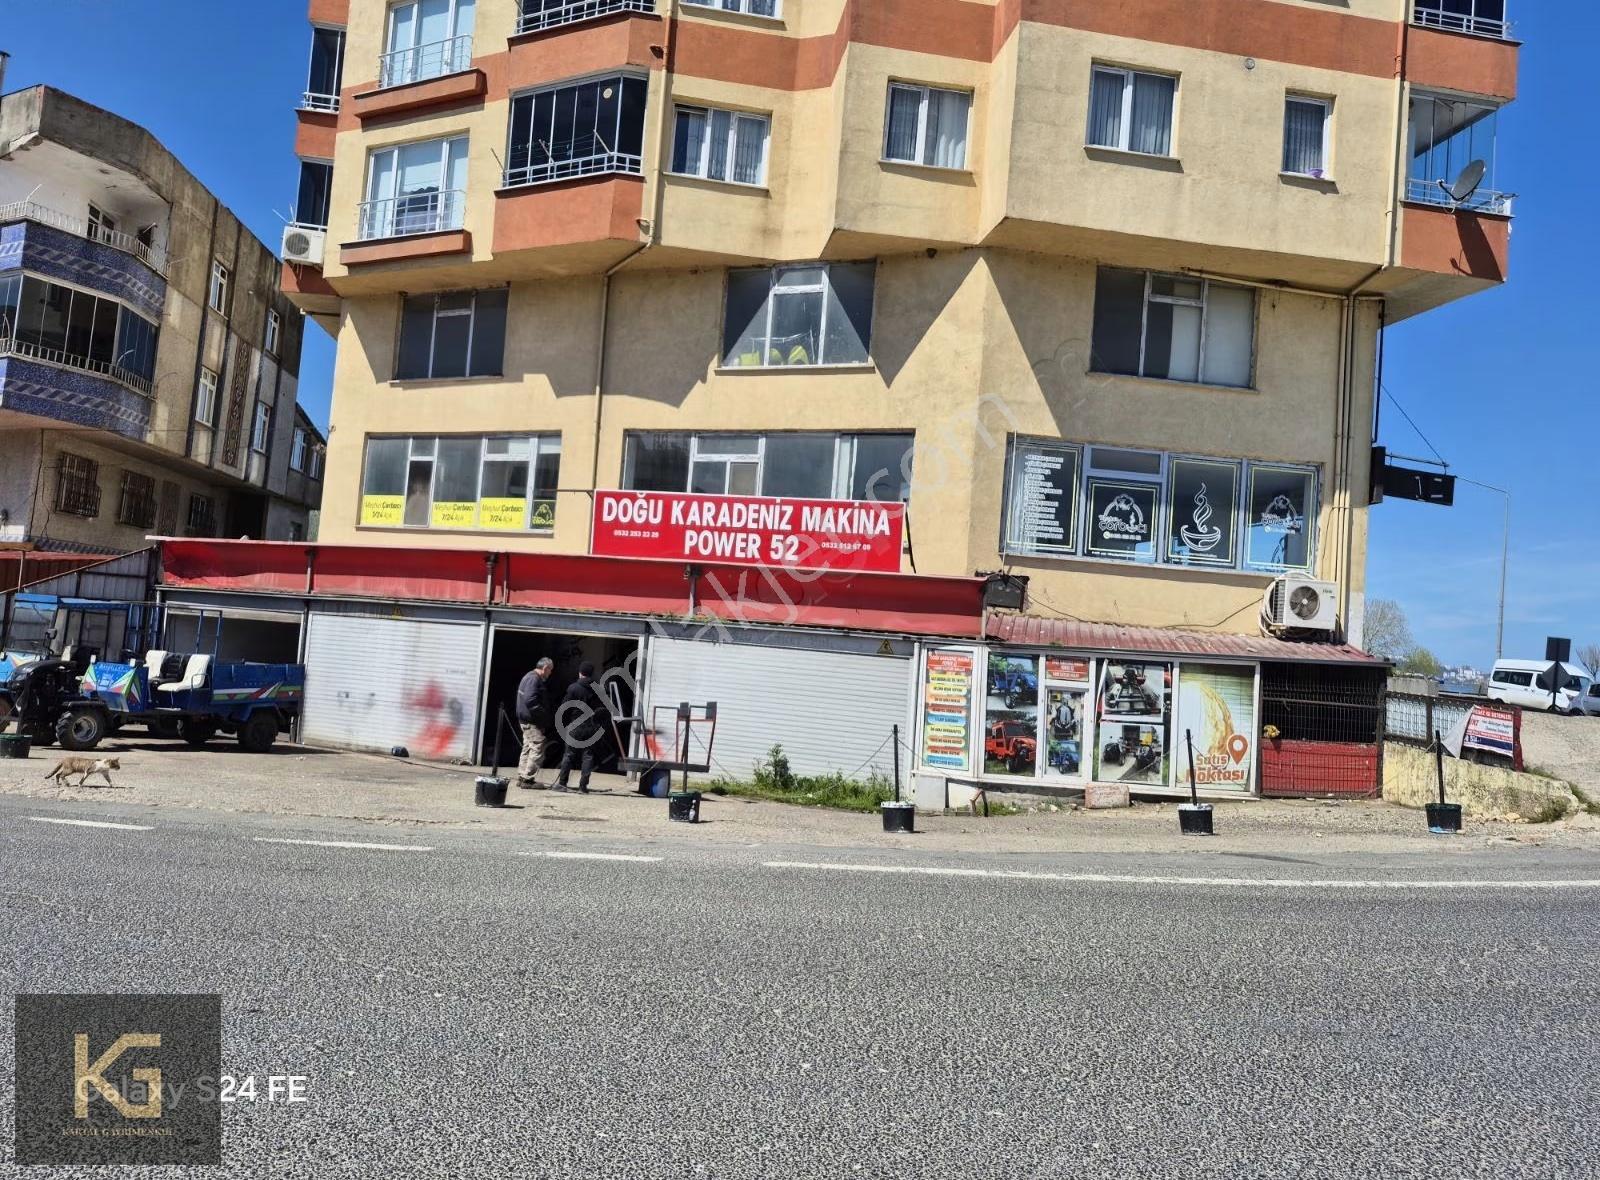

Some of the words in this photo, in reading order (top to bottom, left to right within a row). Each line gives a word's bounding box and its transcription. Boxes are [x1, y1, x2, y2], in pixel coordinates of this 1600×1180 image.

[602, 492, 663, 524] DOĞU
[670, 498, 794, 530] KARADENİZ
[801, 502, 891, 536] MAKİNA
[683, 529, 762, 559] POWER
[769, 534, 799, 561] 52
